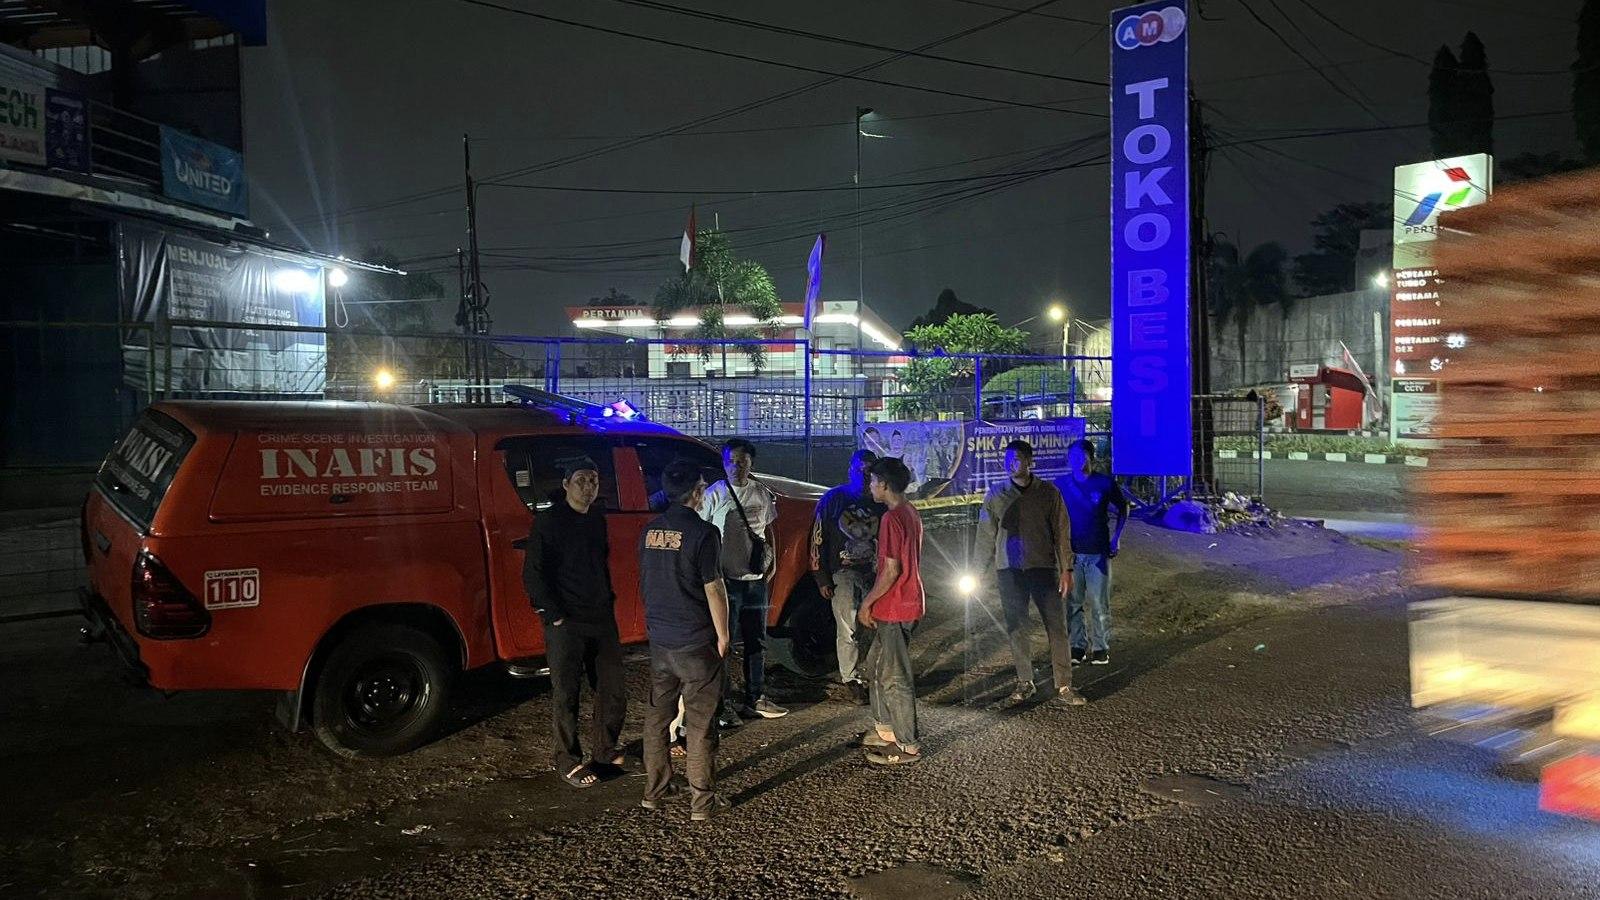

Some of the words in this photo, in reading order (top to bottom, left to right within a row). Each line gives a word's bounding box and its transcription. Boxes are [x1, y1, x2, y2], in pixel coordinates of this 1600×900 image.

[173, 157, 232, 195] UNITED
[1124, 77, 1174, 251] TOKO
[1405, 225, 1438, 235] PERT
[166, 244, 232, 272] MENJUAL
[582, 308, 645, 320] PERTAMINA
[1127, 268, 1169, 437] BESI
[258, 433, 300, 444] CRIME
[303, 433, 345, 444] SCENE
[348, 432, 437, 444] INVESTIGATION
[967, 435, 996, 452] SMK
[117, 427, 173, 483] POLISI
[259, 447, 438, 479] INAFIS
[260, 483, 329, 496] EVIDENCE
[332, 481, 401, 495] RESPONSE
[404, 480, 438, 492] TEAM
[210, 579, 256, 602] 110
